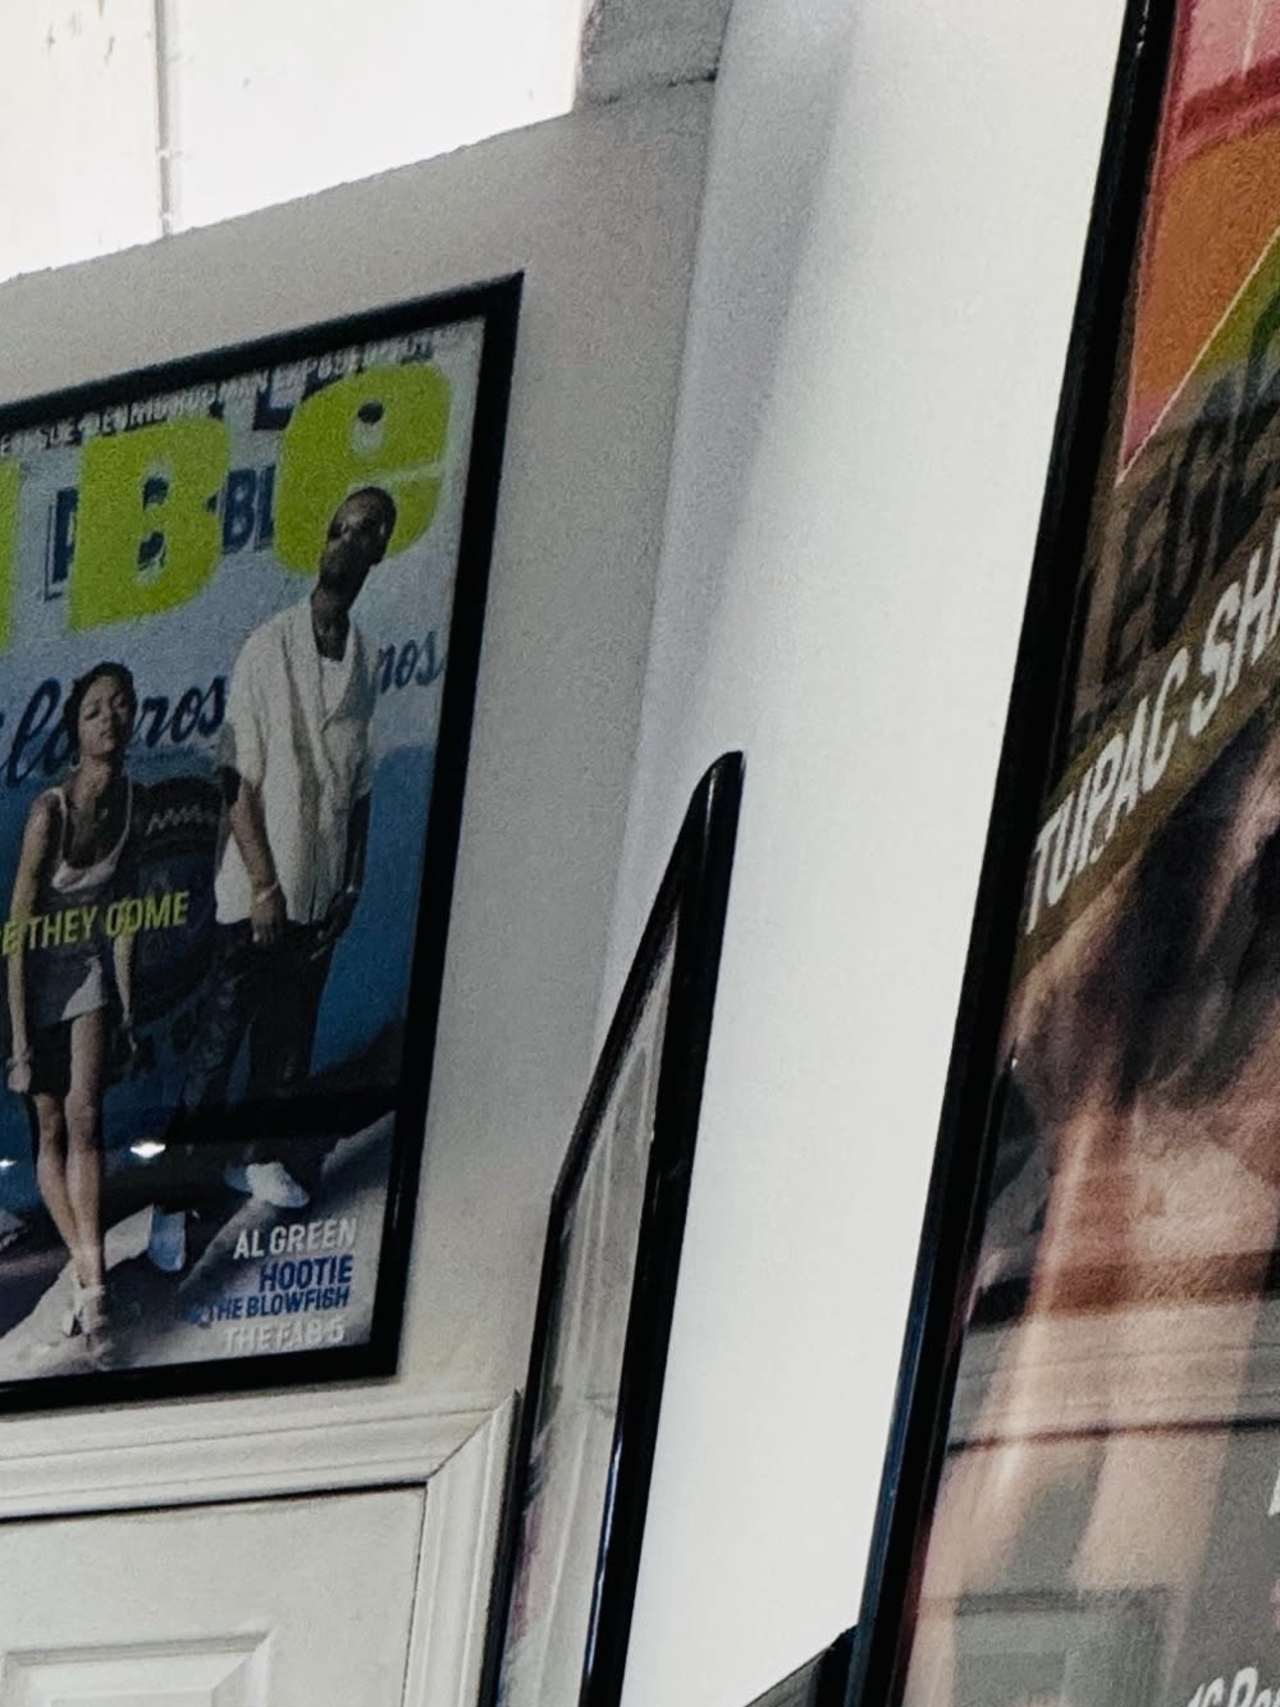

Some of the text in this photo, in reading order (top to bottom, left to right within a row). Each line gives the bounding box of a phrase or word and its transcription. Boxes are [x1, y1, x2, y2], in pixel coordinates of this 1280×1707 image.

[1025, 645, 1191, 937] TUPAC
[23, 906, 97, 952] THEY
[104, 889, 191, 938] COME
[232, 1216, 358, 1261] AL GREEN
[258, 1253, 354, 1293] HOOTIE
[207, 1285, 352, 1322] THE BLOWFISH
[222, 1325, 275, 1353] THE
